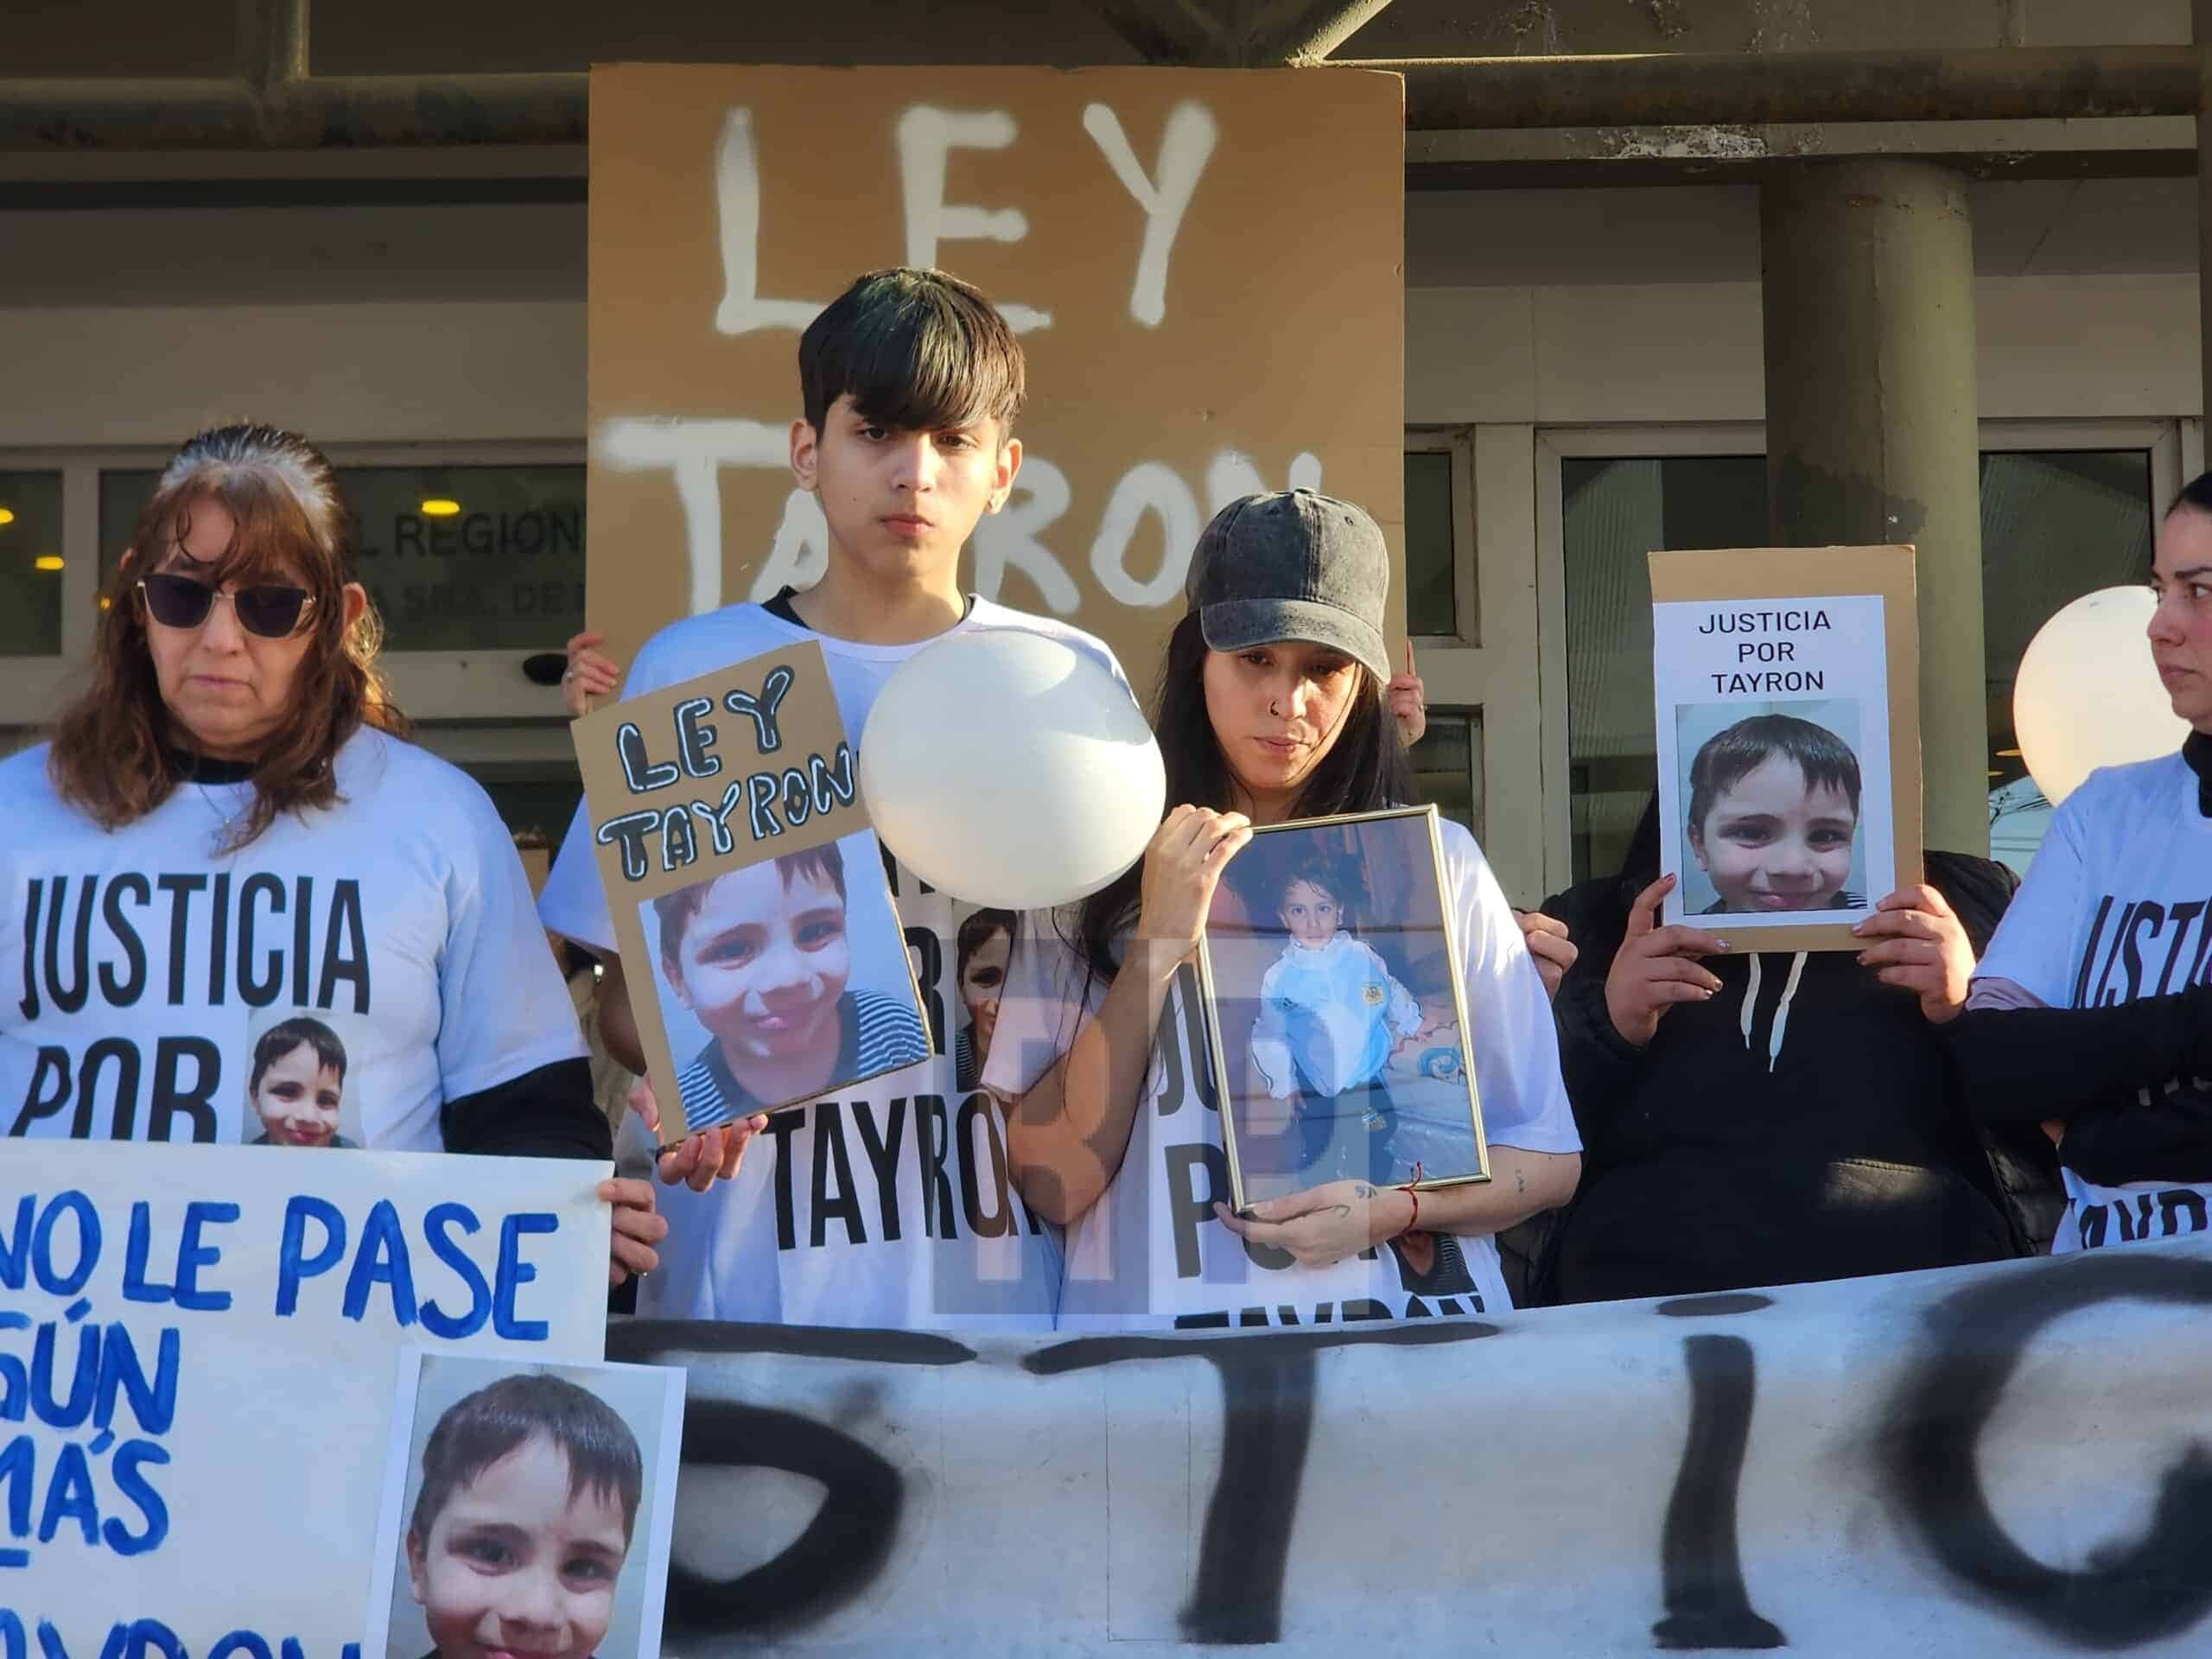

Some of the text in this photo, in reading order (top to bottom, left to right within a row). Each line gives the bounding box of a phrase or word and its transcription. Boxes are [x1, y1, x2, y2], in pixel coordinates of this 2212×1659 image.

[715, 99, 1218, 337] LEY
[594, 415, 1324, 615] TARO
[1699, 610, 1831, 634] JUSTICIA
[1711, 671, 1823, 694] TAYRON
[1738, 641, 1795, 663] POR
[616, 664, 795, 794] LEY
[596, 741, 856, 882] TAYRON
[19, 870, 371, 1021] JUSTICIA
[9, 1035, 222, 1145] POR
[122, 1200, 241, 1312] LE
[276, 1194, 559, 1342] PASE
